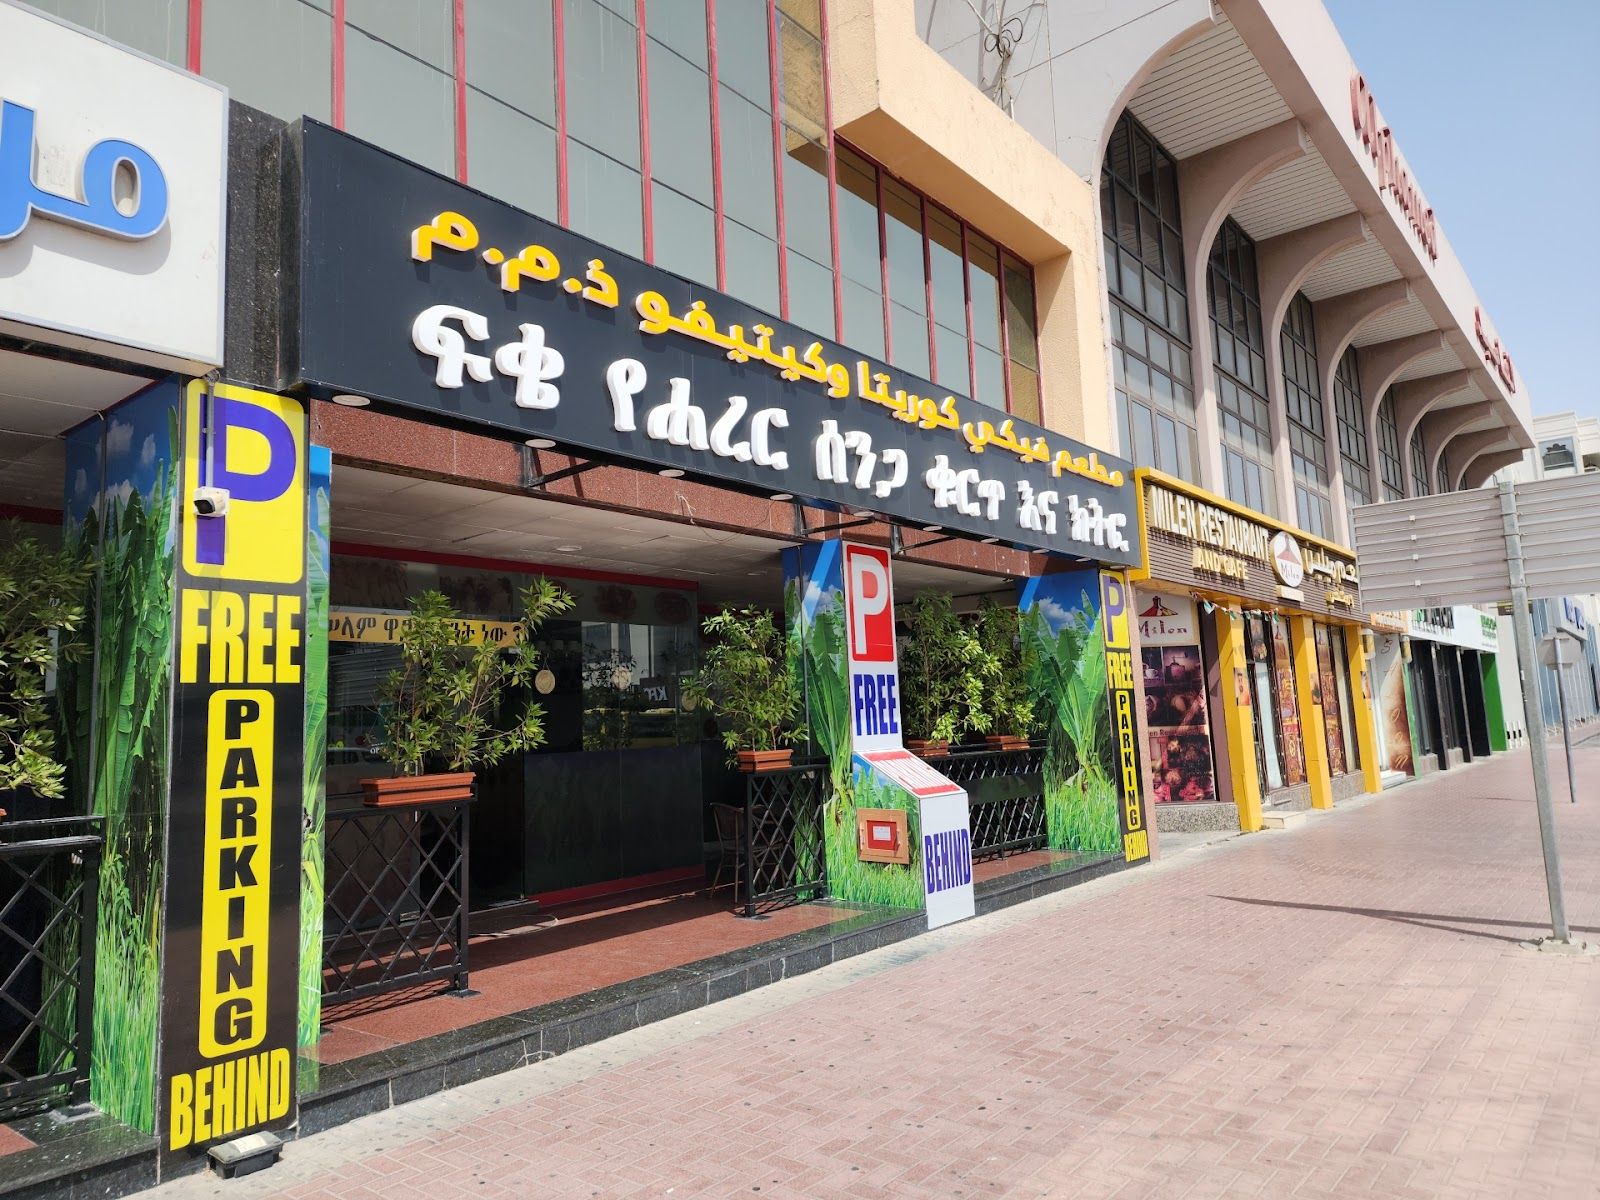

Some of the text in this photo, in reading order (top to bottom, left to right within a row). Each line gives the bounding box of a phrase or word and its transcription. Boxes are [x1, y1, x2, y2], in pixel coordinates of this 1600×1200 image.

[635, 291, 849, 398] وكيتيفو
[856, 361, 960, 430] كوريتا
[196, 393, 297, 566] P
[815, 419, 909, 498] ሰንጋ
[1017, 479, 1059, 535] እና
[1052, 450, 1124, 487] مطعم
[1150, 485, 1270, 562] MILEN RESTAURANT
[1193, 547, 1249, 580] AND CAFE
[179, 588, 301, 684] FREE
[850, 552, 889, 655] P
[1102, 575, 1124, 643] P
[853, 673, 899, 736] FREE
[1106, 651, 1134, 690] FREE
[1119, 694, 1138, 827] PARKING
[214, 699, 259, 1046] PARKING
[924, 828, 972, 895] BEHIND
[170, 1047, 290, 1152] BEHIND
